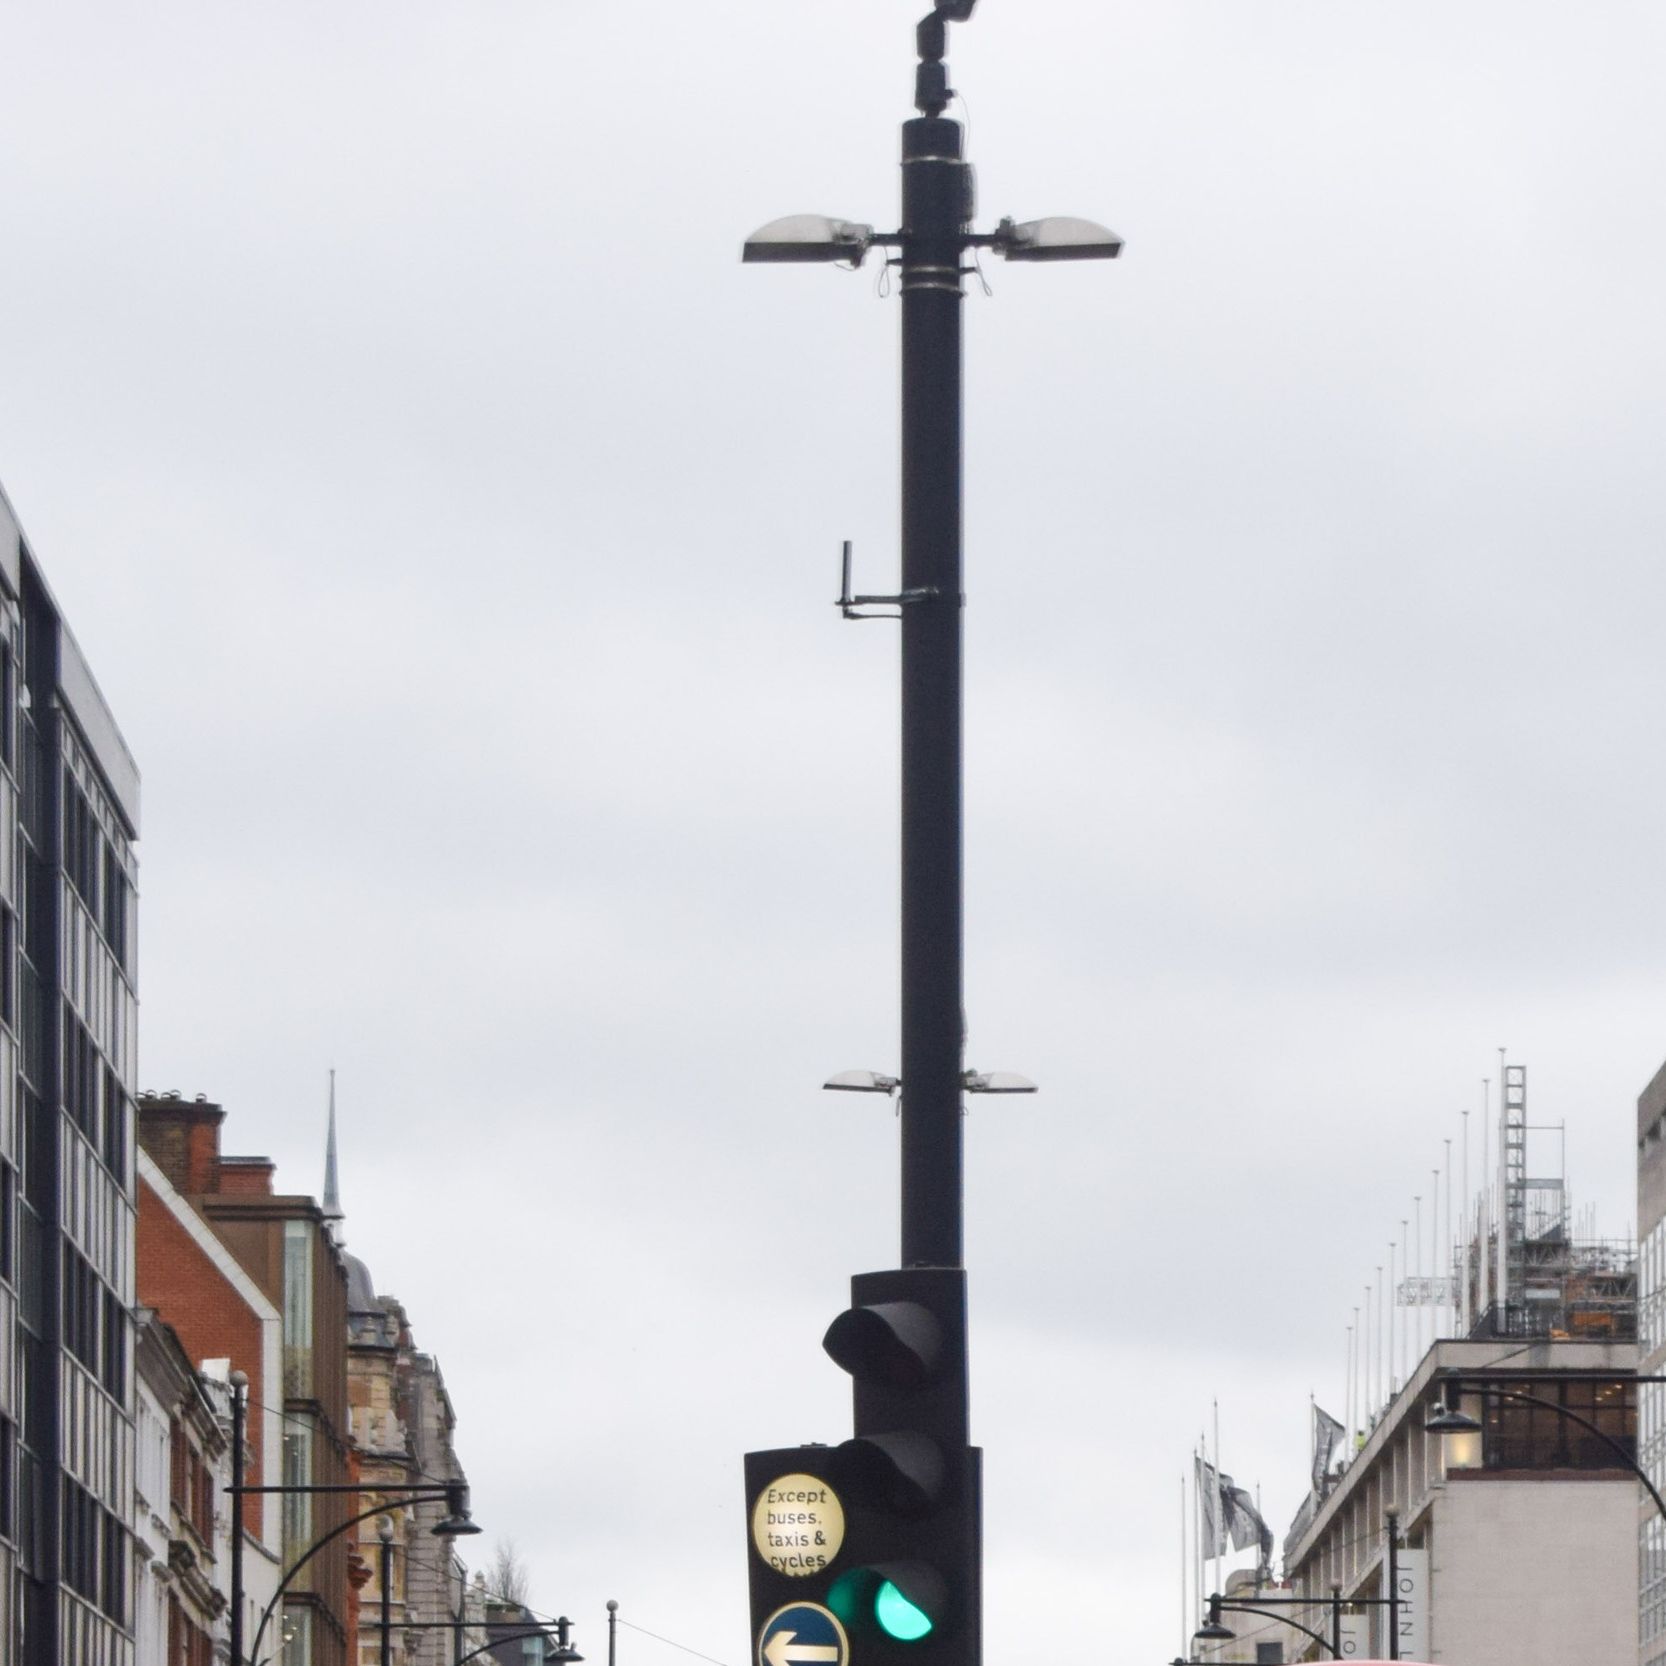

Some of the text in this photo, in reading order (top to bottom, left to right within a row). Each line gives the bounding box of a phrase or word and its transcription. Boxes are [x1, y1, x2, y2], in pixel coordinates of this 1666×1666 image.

[767, 1488, 827, 1506] Except
[767, 1530, 827, 1547] taxis &
[770, 1552, 827, 1573] cycles
